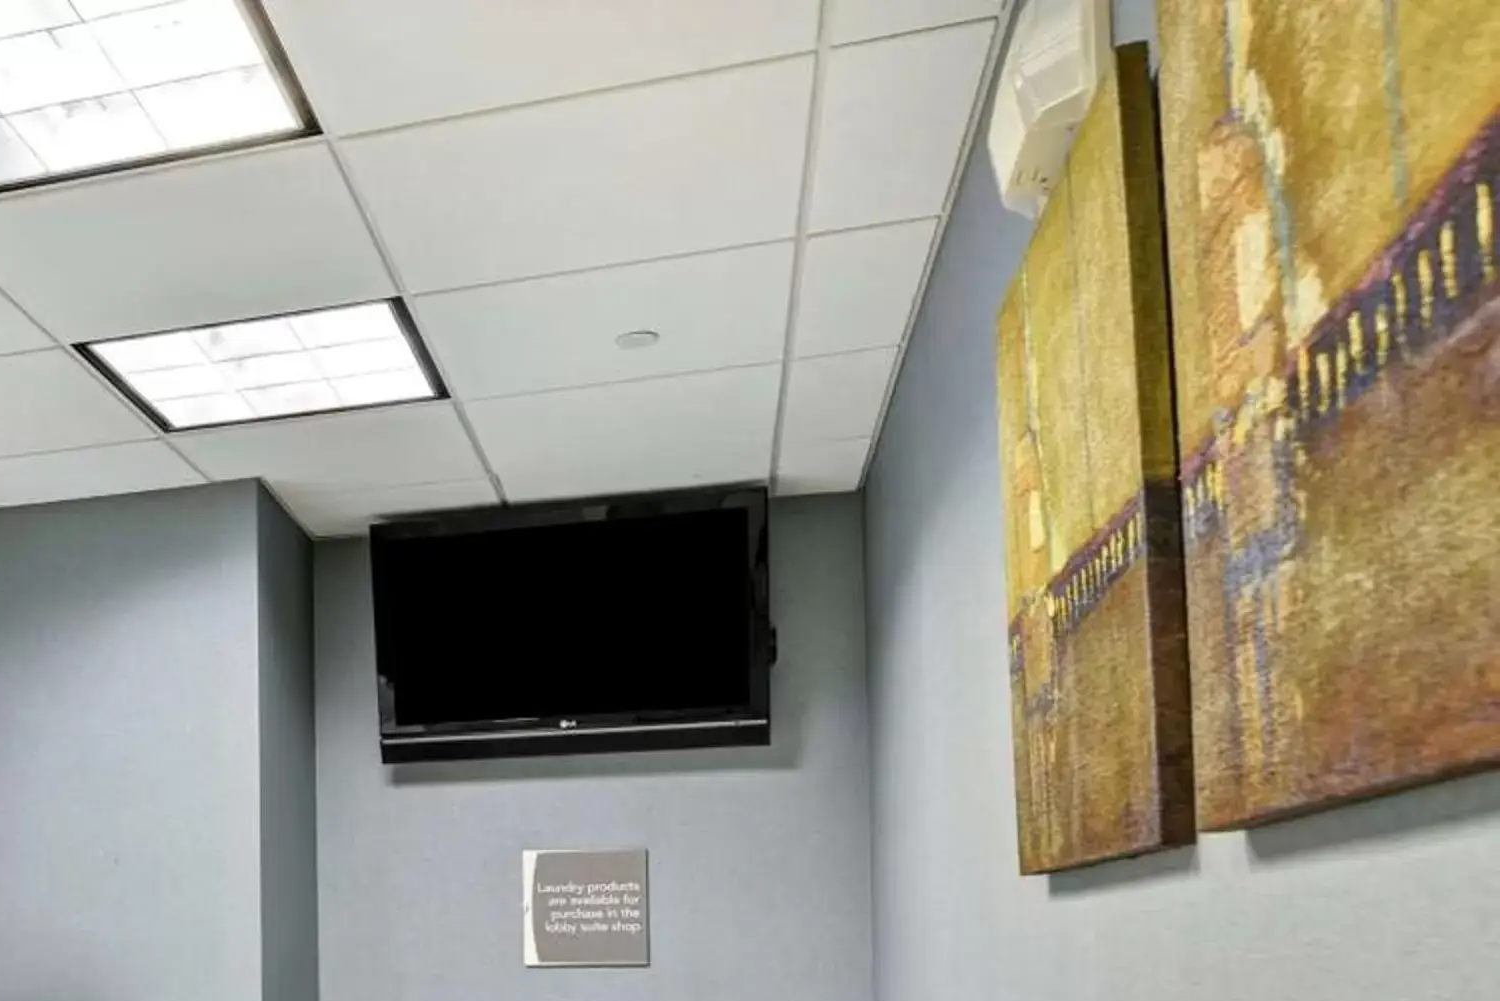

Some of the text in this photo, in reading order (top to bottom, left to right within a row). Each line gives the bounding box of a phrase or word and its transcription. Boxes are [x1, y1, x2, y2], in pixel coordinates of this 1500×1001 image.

[537, 880, 640, 896] Laundry products
[569, 894, 620, 905] available
[623, 892, 640, 905] for
[549, 907, 640, 922] purchase in the
[544, 919, 577, 935] lobby
